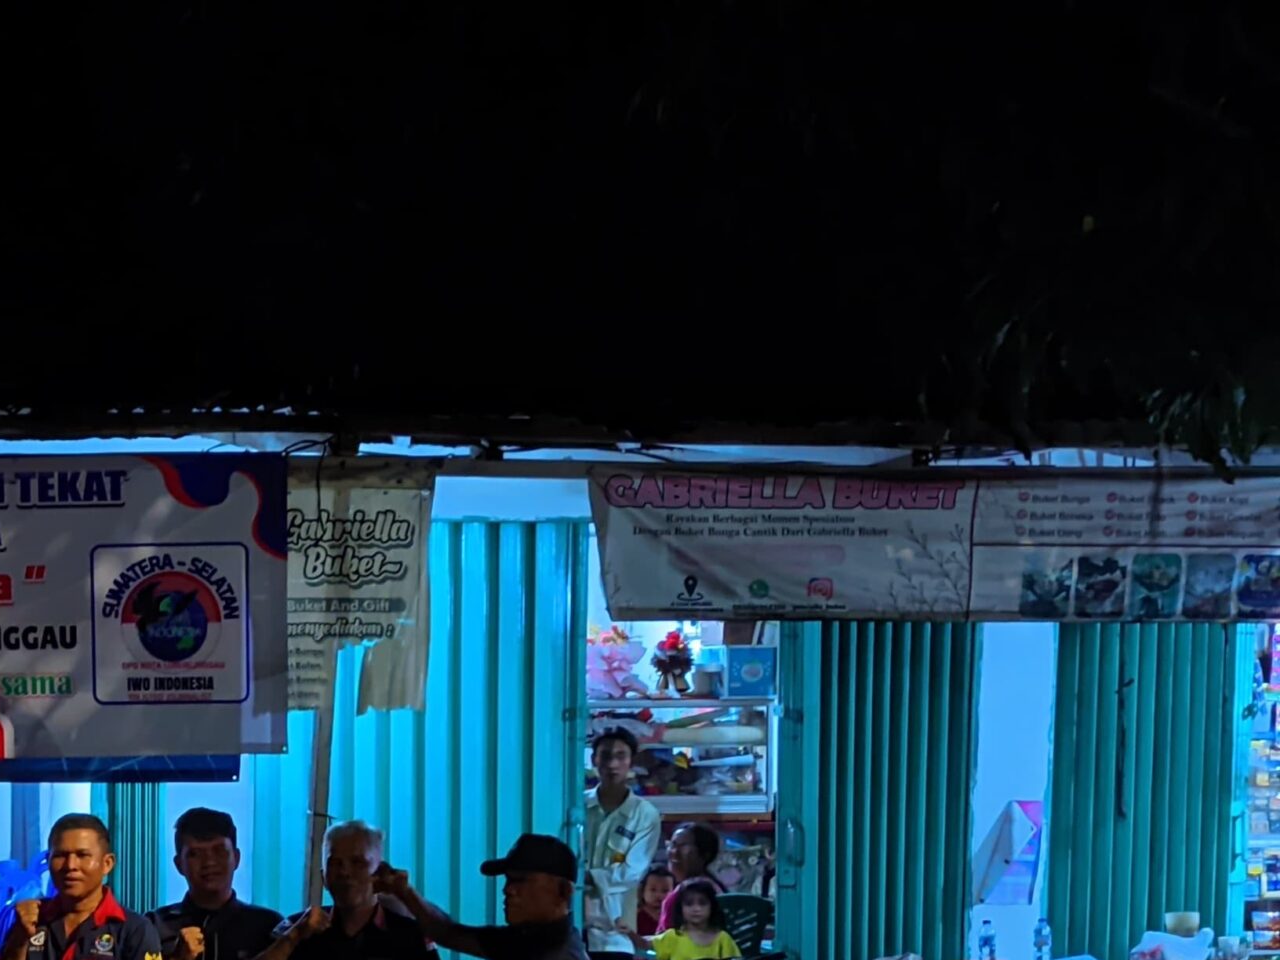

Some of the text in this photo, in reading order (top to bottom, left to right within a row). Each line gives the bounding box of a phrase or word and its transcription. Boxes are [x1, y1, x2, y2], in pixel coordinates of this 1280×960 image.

[15, 470, 127, 502] TEKAT
[604, 474, 966, 510] GABRIELLA BUKET
[287, 510, 412, 546] Gabriella
[304, 547, 404, 583] Buket
[102, 553, 175, 619] SUMATERA
[187, 557, 240, 620] SELATAN
[330, 600, 359, 612] And
[363, 600, 390, 612] Gift
[127, 676, 215, 692] IWO INDONESIA
